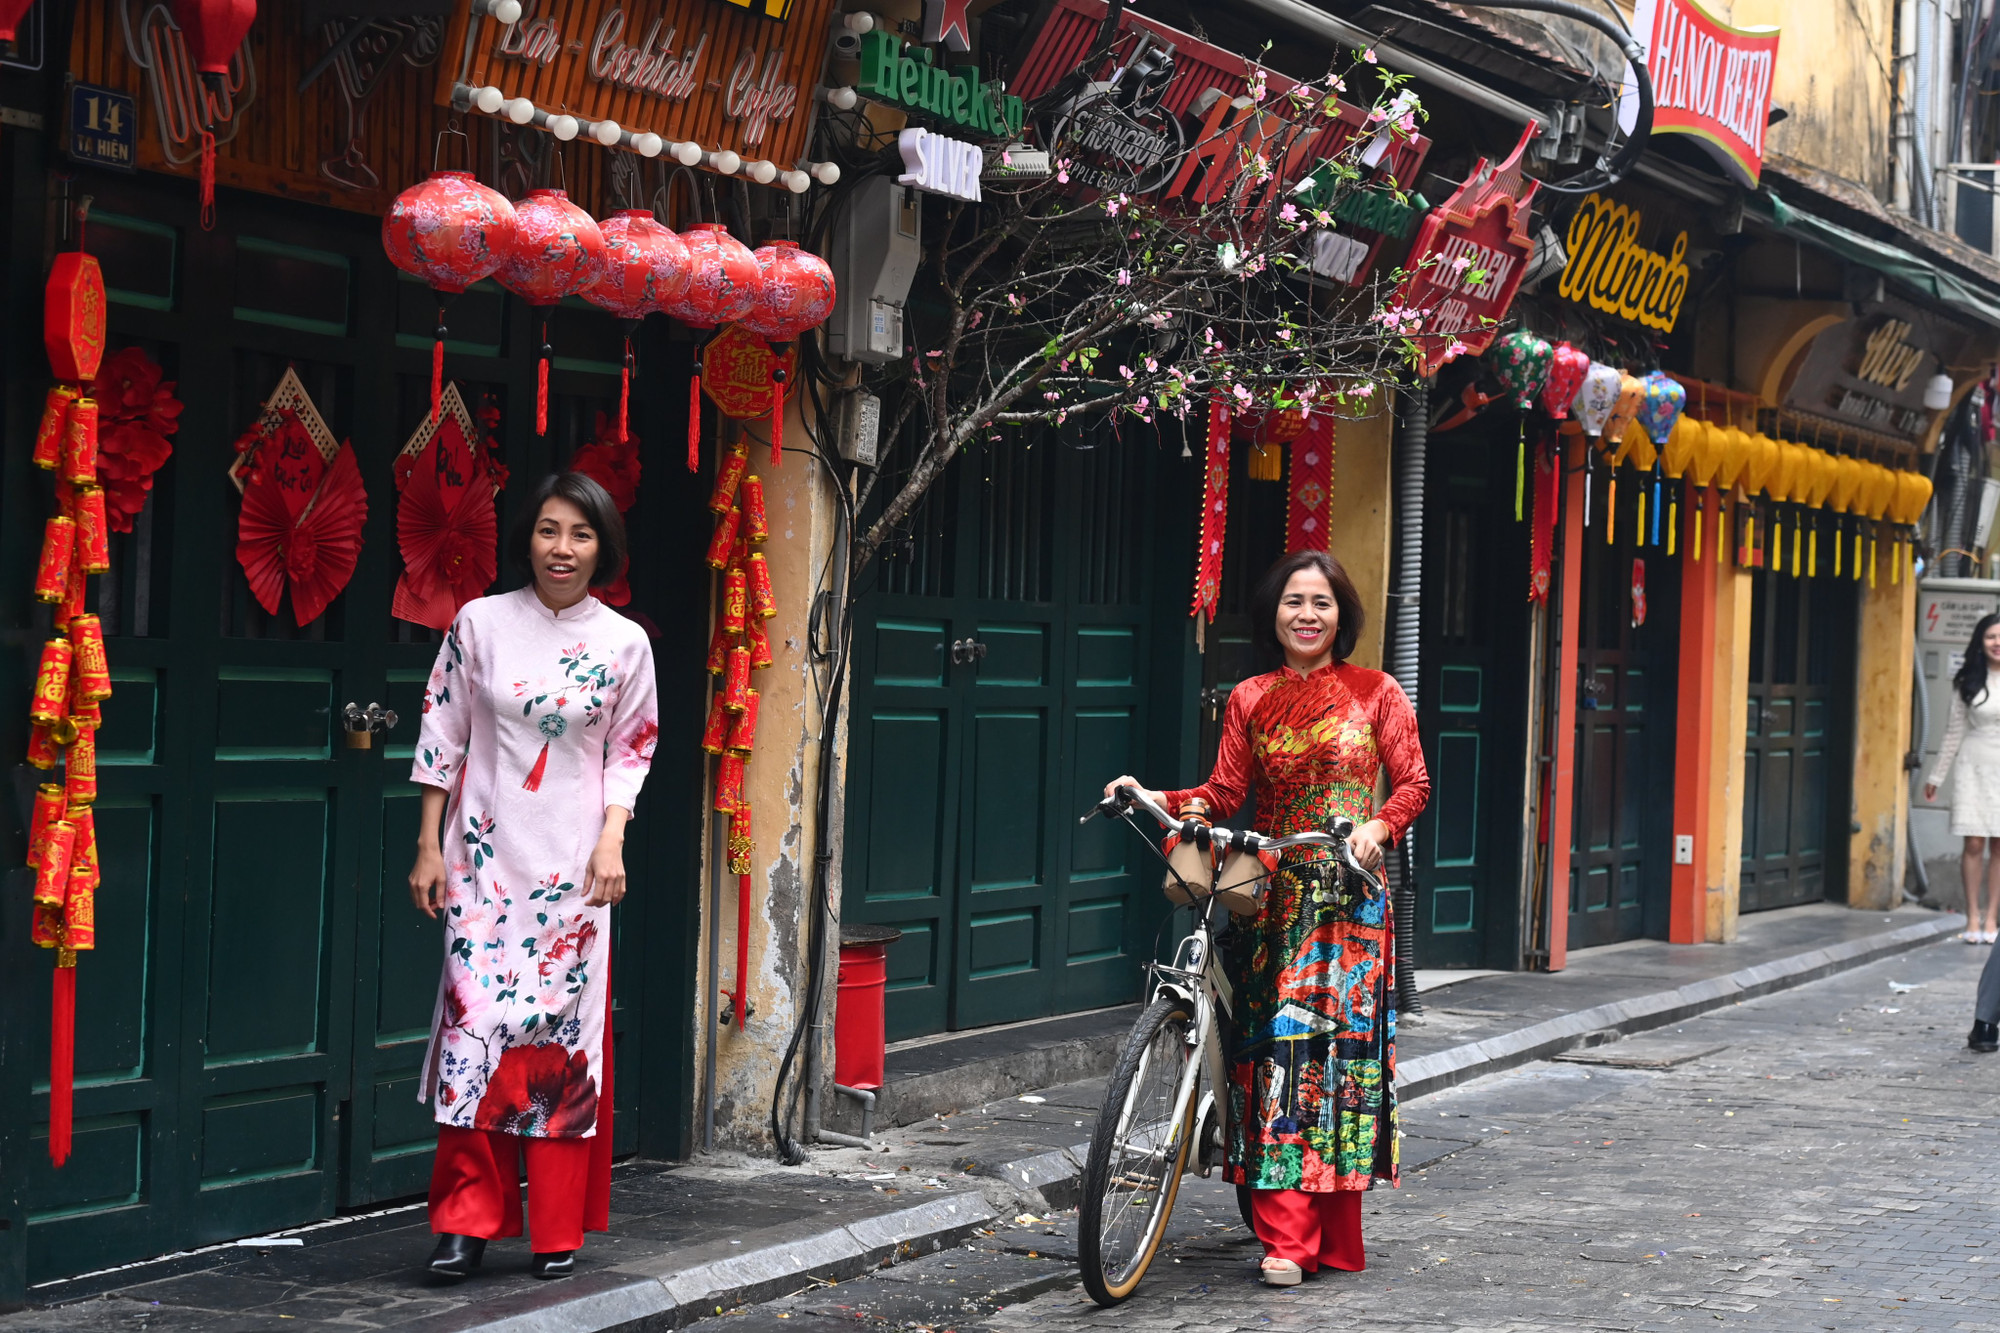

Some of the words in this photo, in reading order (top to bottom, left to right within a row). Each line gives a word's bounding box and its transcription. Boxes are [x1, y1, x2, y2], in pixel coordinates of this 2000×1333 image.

[589, 8, 708, 101] Cocktail
[726, 48, 797, 146] Coffee
[868, 30, 1024, 141] Heineken
[1652, 0, 1725, 119] HANOI
[1717, 45, 1772, 158] BEER
[77, 134, 94, 156] TẠ
[97, 138, 129, 162] HIỆN
[84, 96, 124, 135] 14
[1073, 110, 1177, 167] STRONGBOW
[907, 127, 983, 202] SILVER
[1432, 234, 1517, 302] HIDDEN
[1561, 195, 1687, 330] Minnie
[1431, 298, 1469, 334] PUB
